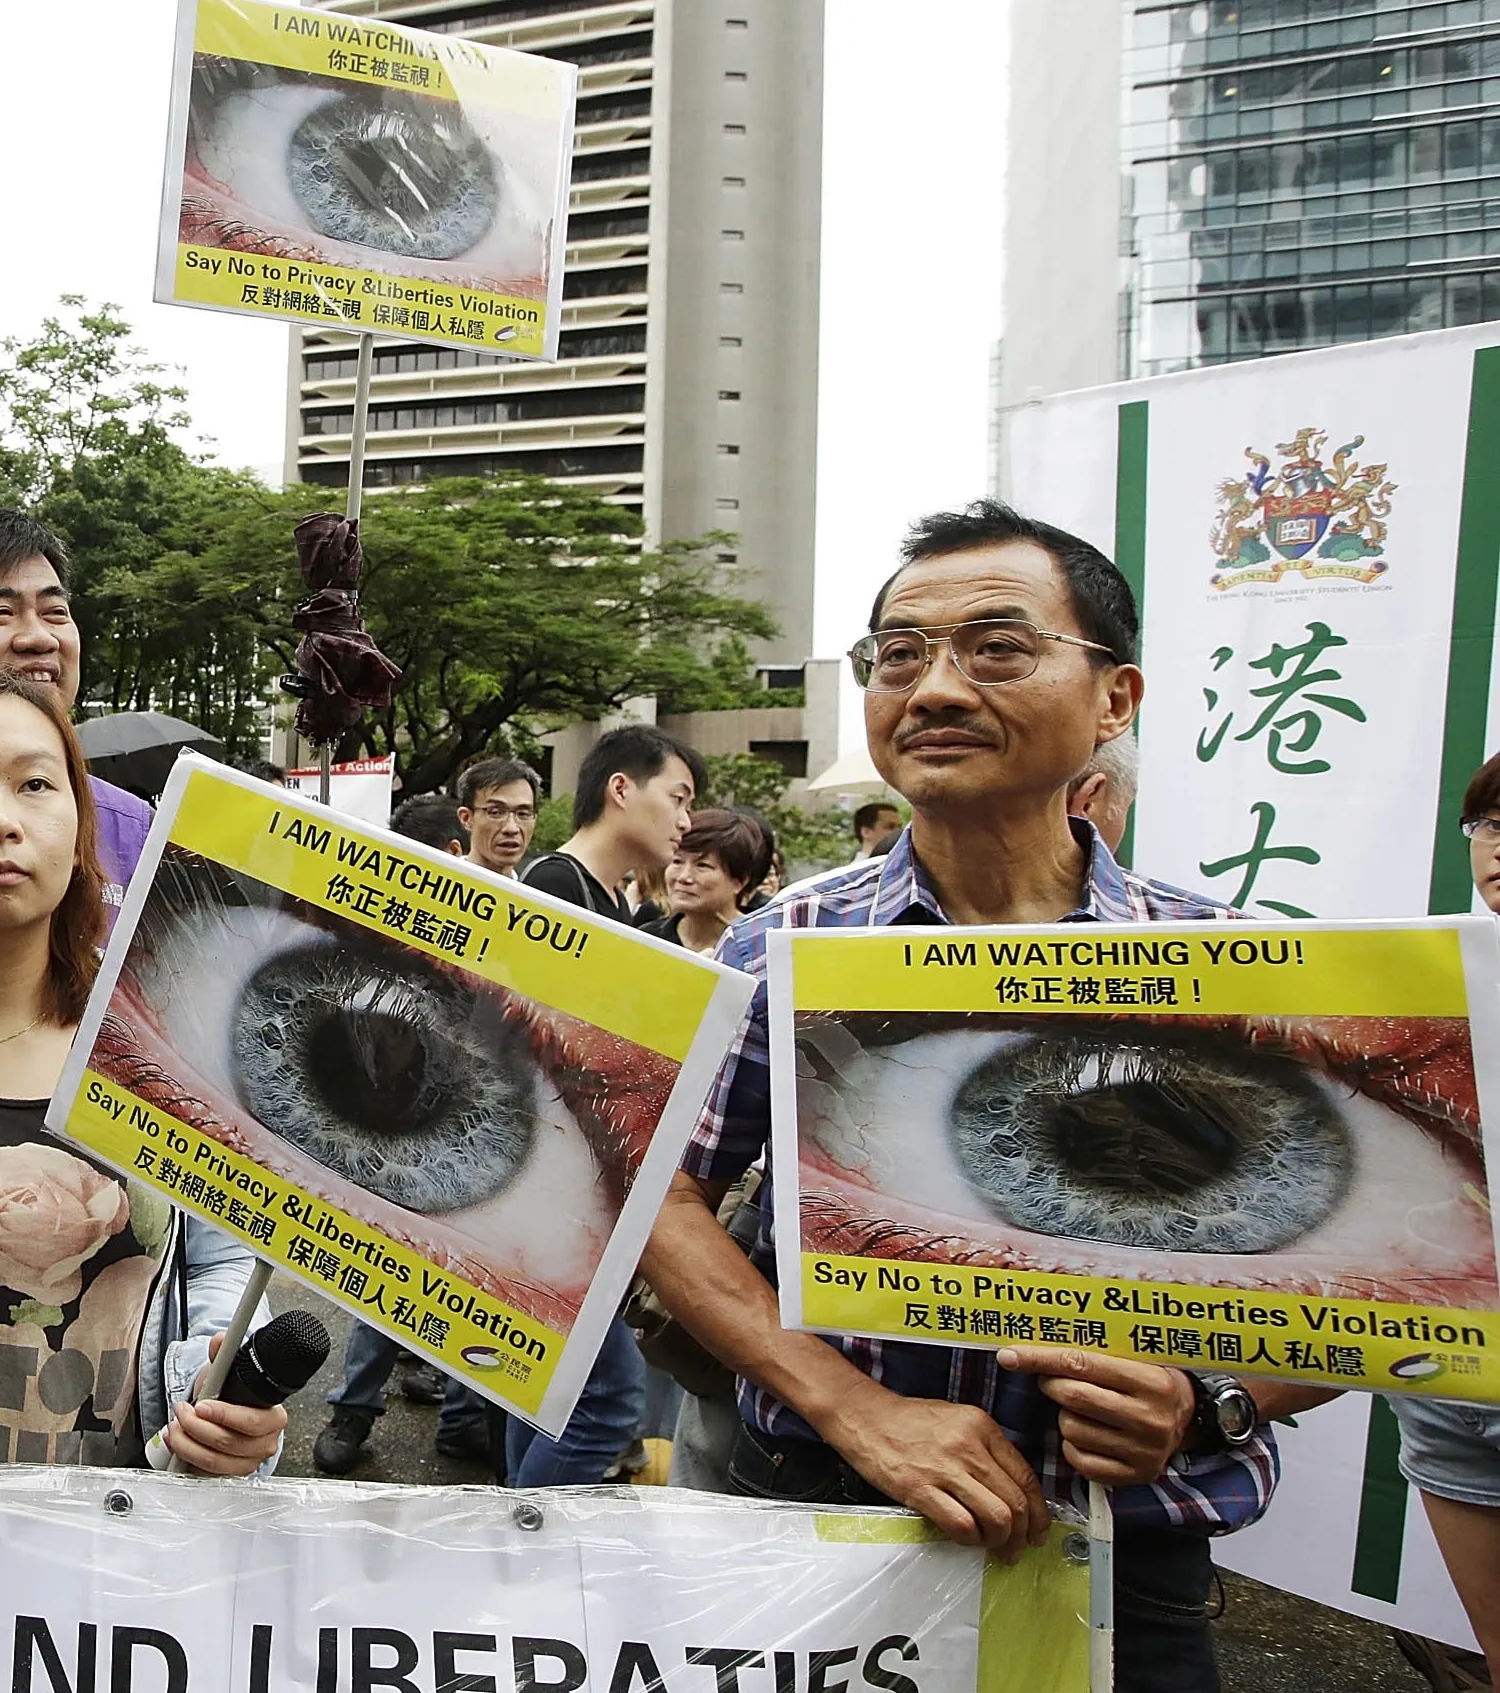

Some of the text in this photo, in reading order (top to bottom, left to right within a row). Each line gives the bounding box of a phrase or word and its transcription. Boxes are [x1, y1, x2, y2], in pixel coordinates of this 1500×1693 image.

[274, 13, 279, 30] I
[285, 16, 320, 38] AM
[185, 251, 538, 323] Say No to Privacy &Liberties Violation
[240, 284, 362, 320] 反對網絡監視
[372, 303, 485, 341] 保障個人私隱
[268, 811, 589, 959] I AM WATCHING YOU!
[903, 939, 1303, 967] I AM WATCHING YOU!
[86, 1081, 547, 1362] Say No to Privacy &Liberties Violation
[133, 1145, 451, 1350] 反對網絡監視 保障個人私隱
[814, 1262, 1485, 1347] Say No to Privacy &Liberties Violation
[904, 1303, 1366, 1377] 反對網絡監視 保障個人私隱
